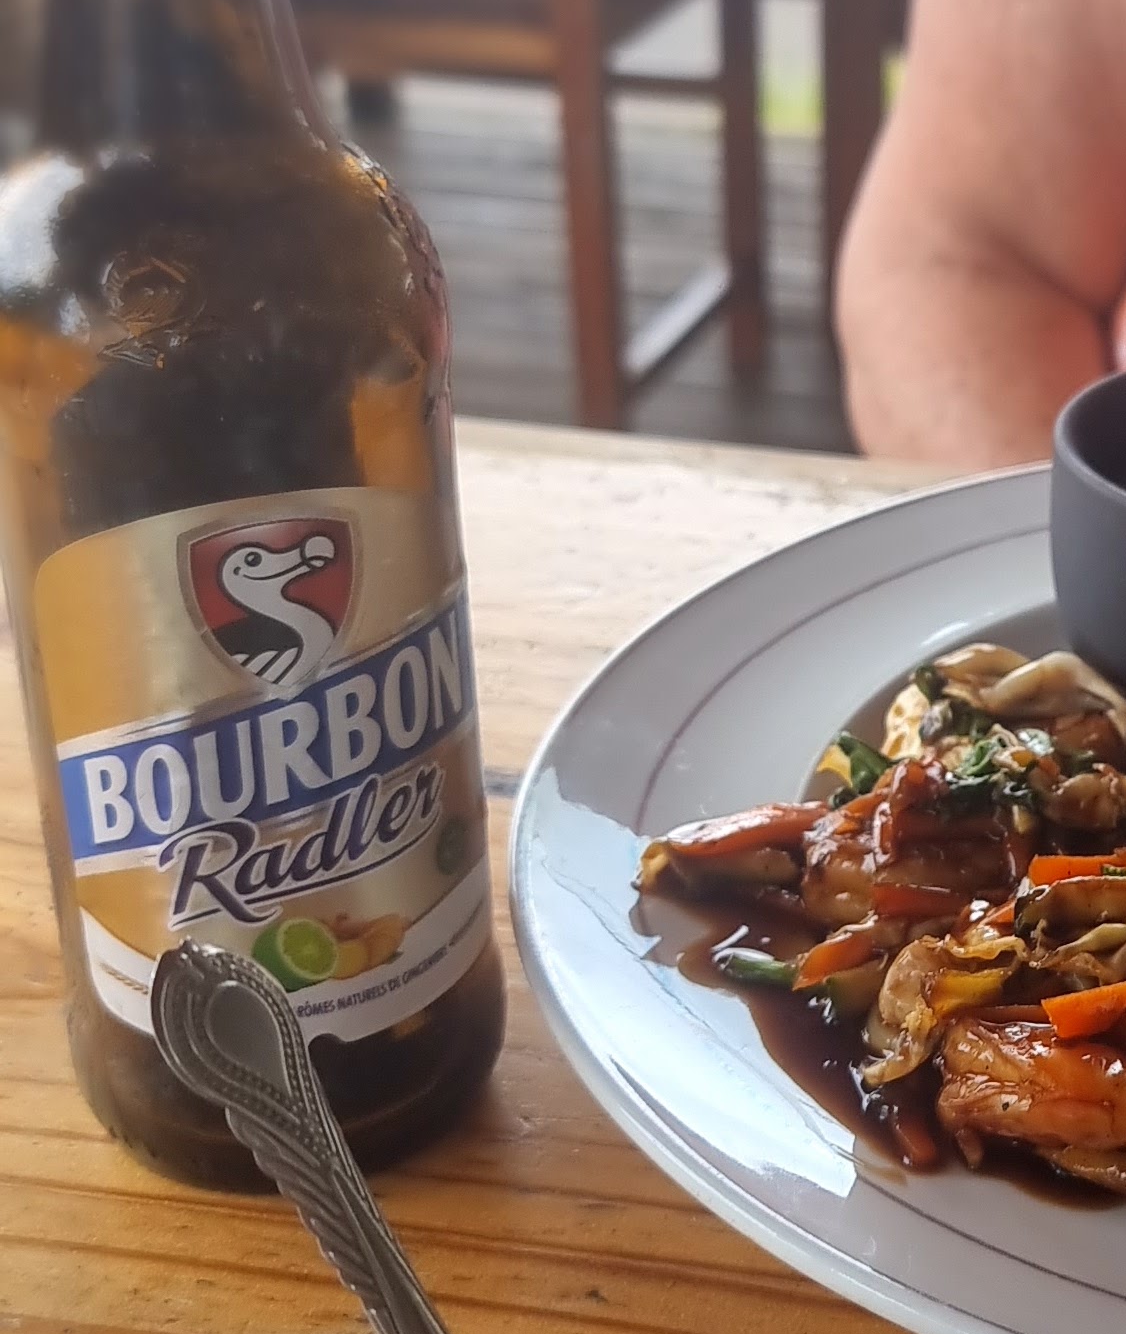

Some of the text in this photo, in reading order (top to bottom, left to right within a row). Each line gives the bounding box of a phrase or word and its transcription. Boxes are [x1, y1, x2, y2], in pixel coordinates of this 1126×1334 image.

[83, 609, 464, 845] BOURBON
[157, 763, 442, 926] Radler
[296, 1000, 336, 1018] RÔMES
